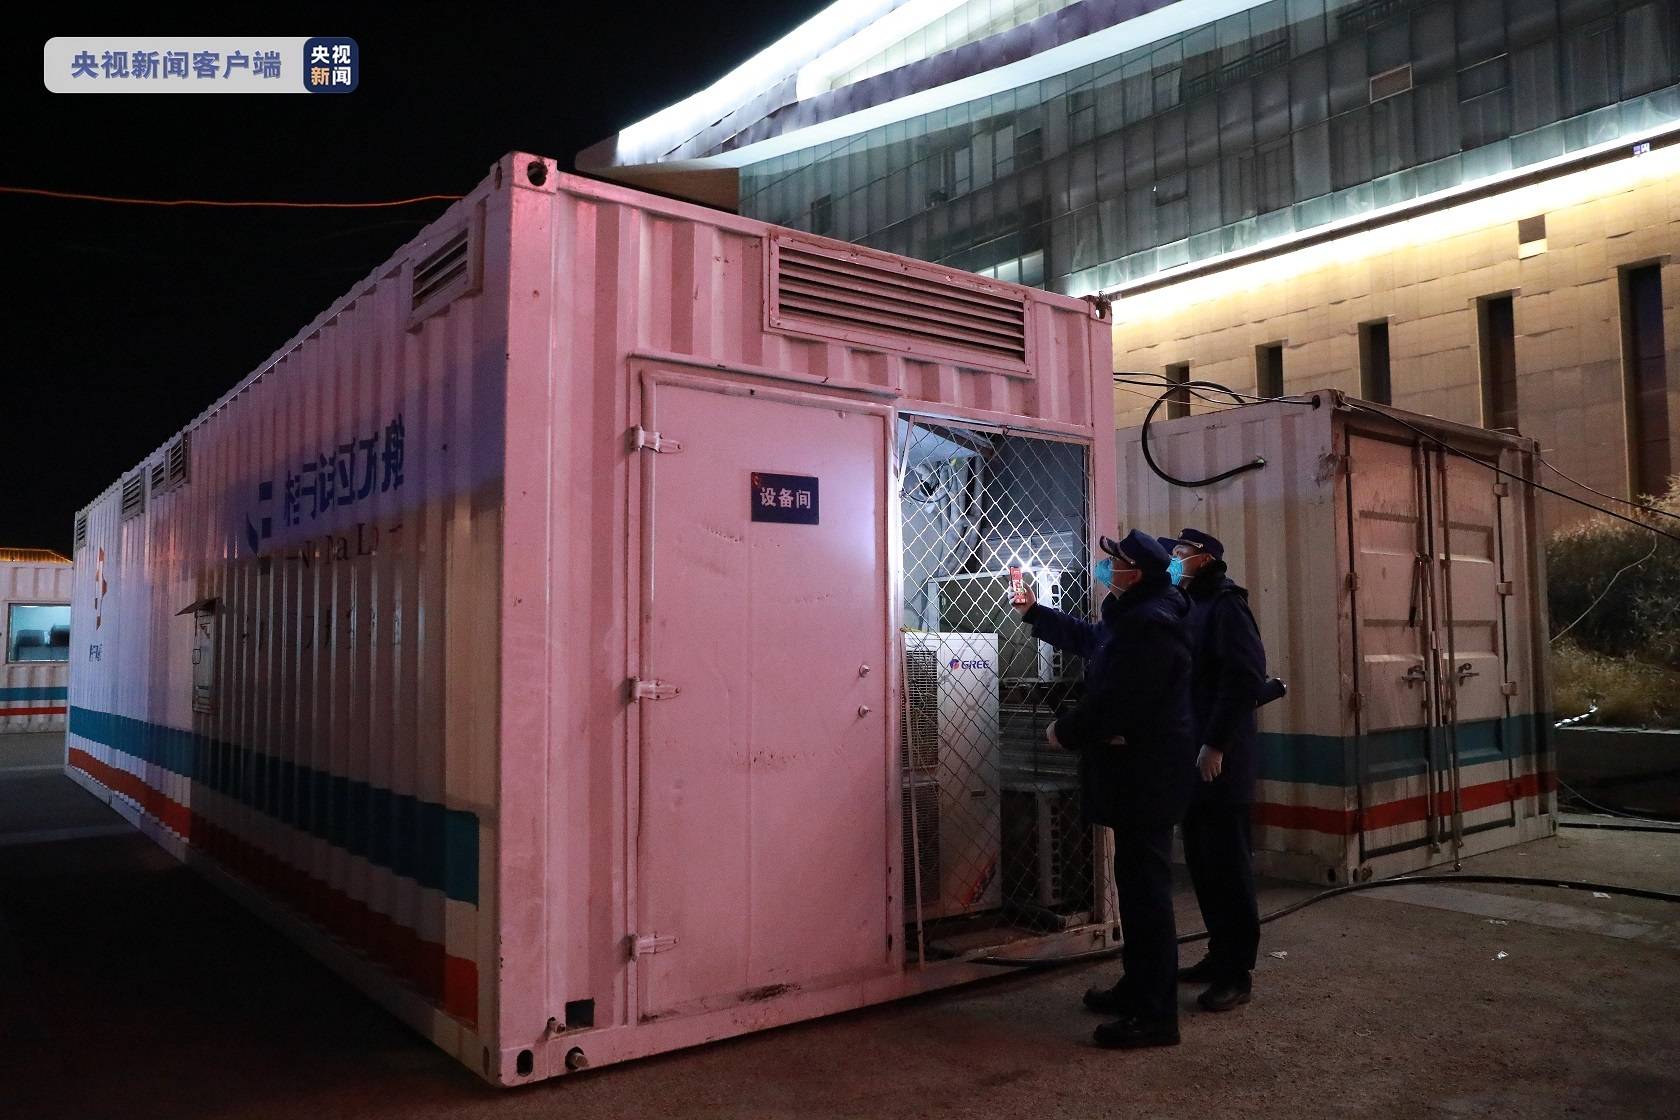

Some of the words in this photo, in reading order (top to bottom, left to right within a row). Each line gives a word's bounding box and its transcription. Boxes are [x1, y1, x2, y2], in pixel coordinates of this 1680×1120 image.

[760, 487, 811, 509] 设备间
[961, 660, 990, 670] GREE
